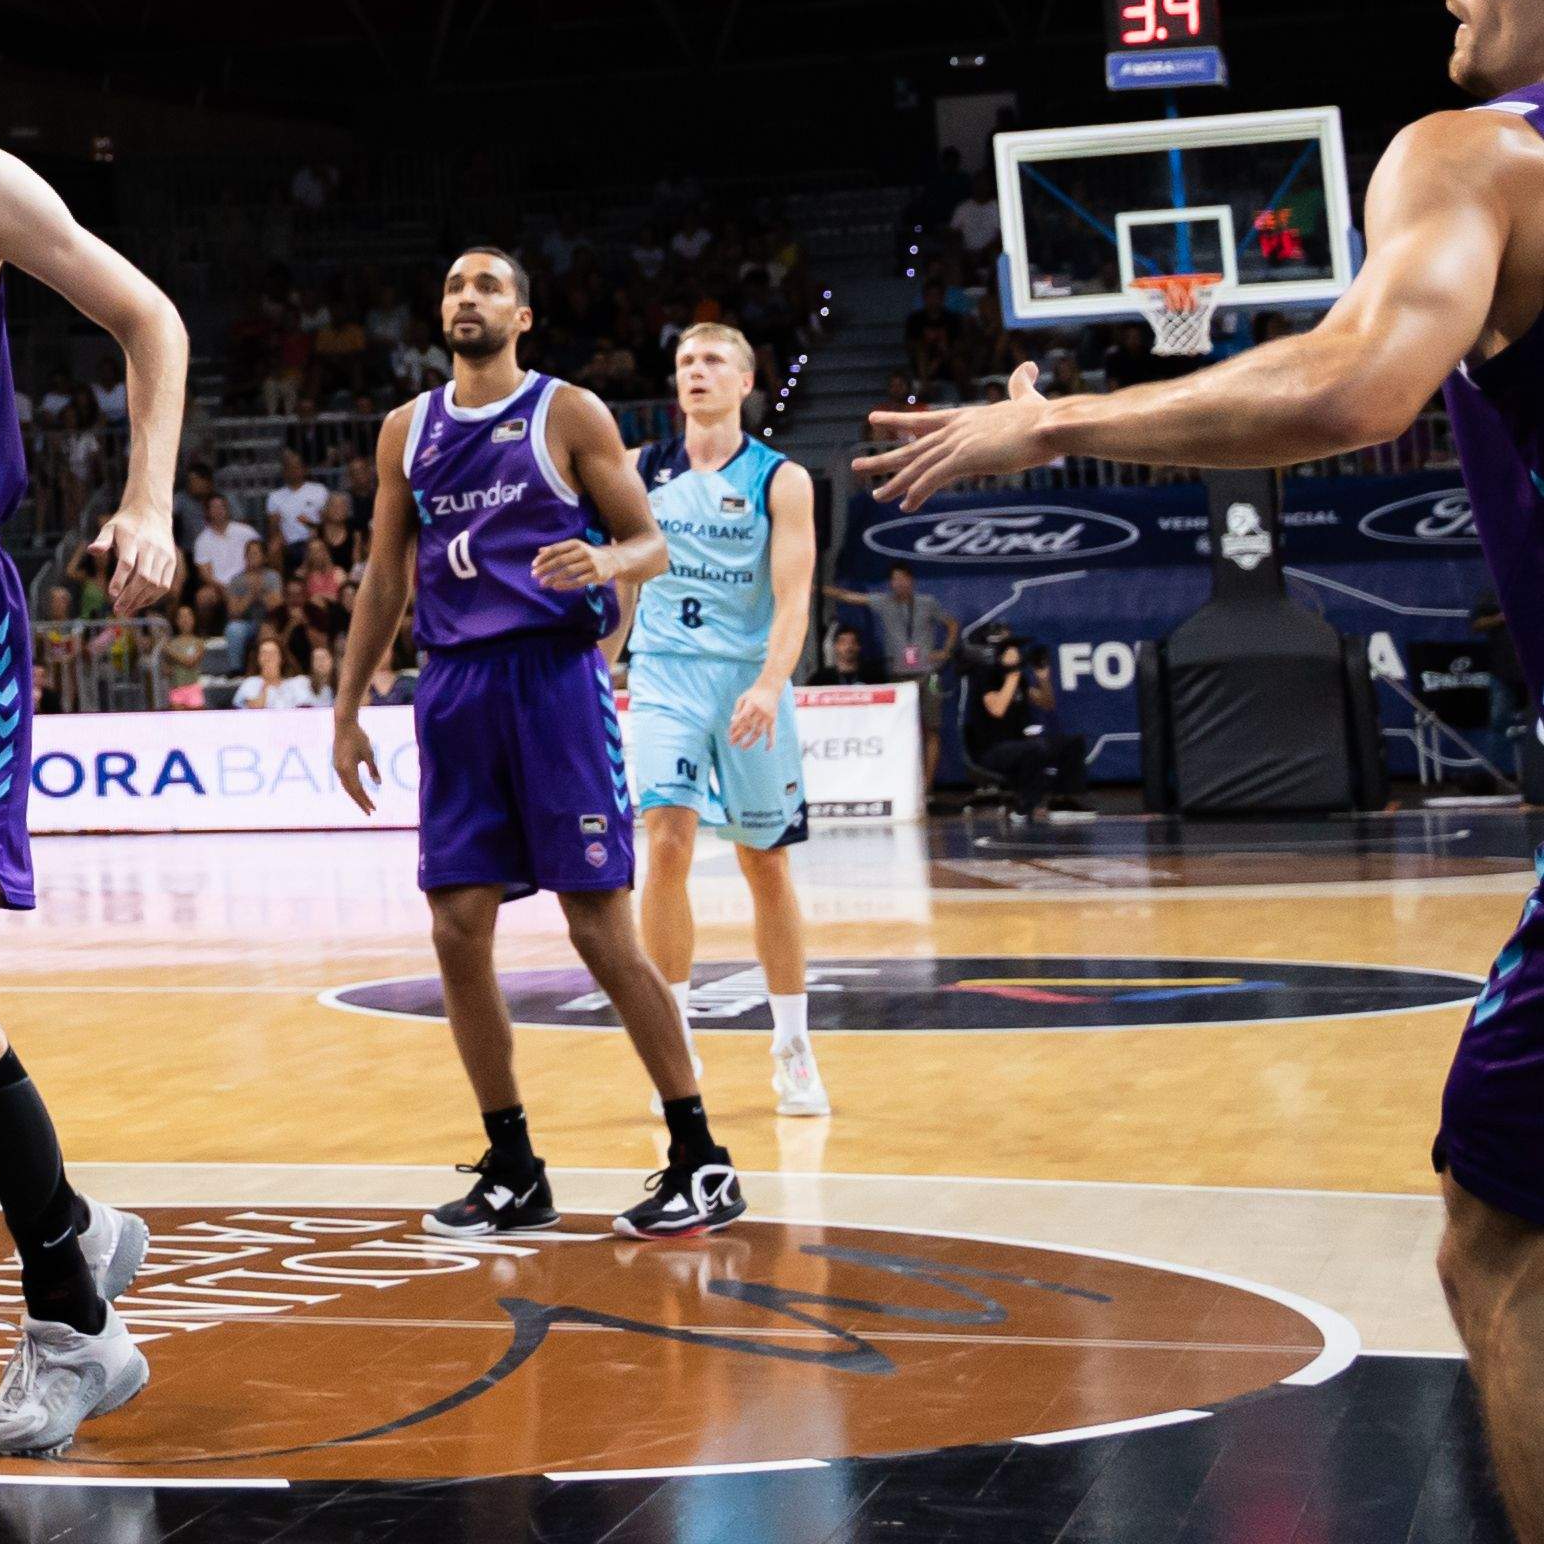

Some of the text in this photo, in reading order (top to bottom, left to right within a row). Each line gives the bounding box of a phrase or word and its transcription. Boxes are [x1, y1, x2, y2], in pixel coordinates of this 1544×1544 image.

[431, 480, 528, 515] zunder
[658, 519, 754, 540] MORABANC
[912, 513, 1086, 558] Ford
[447, 530, 478, 579] 0
[681, 597, 704, 629] 8
